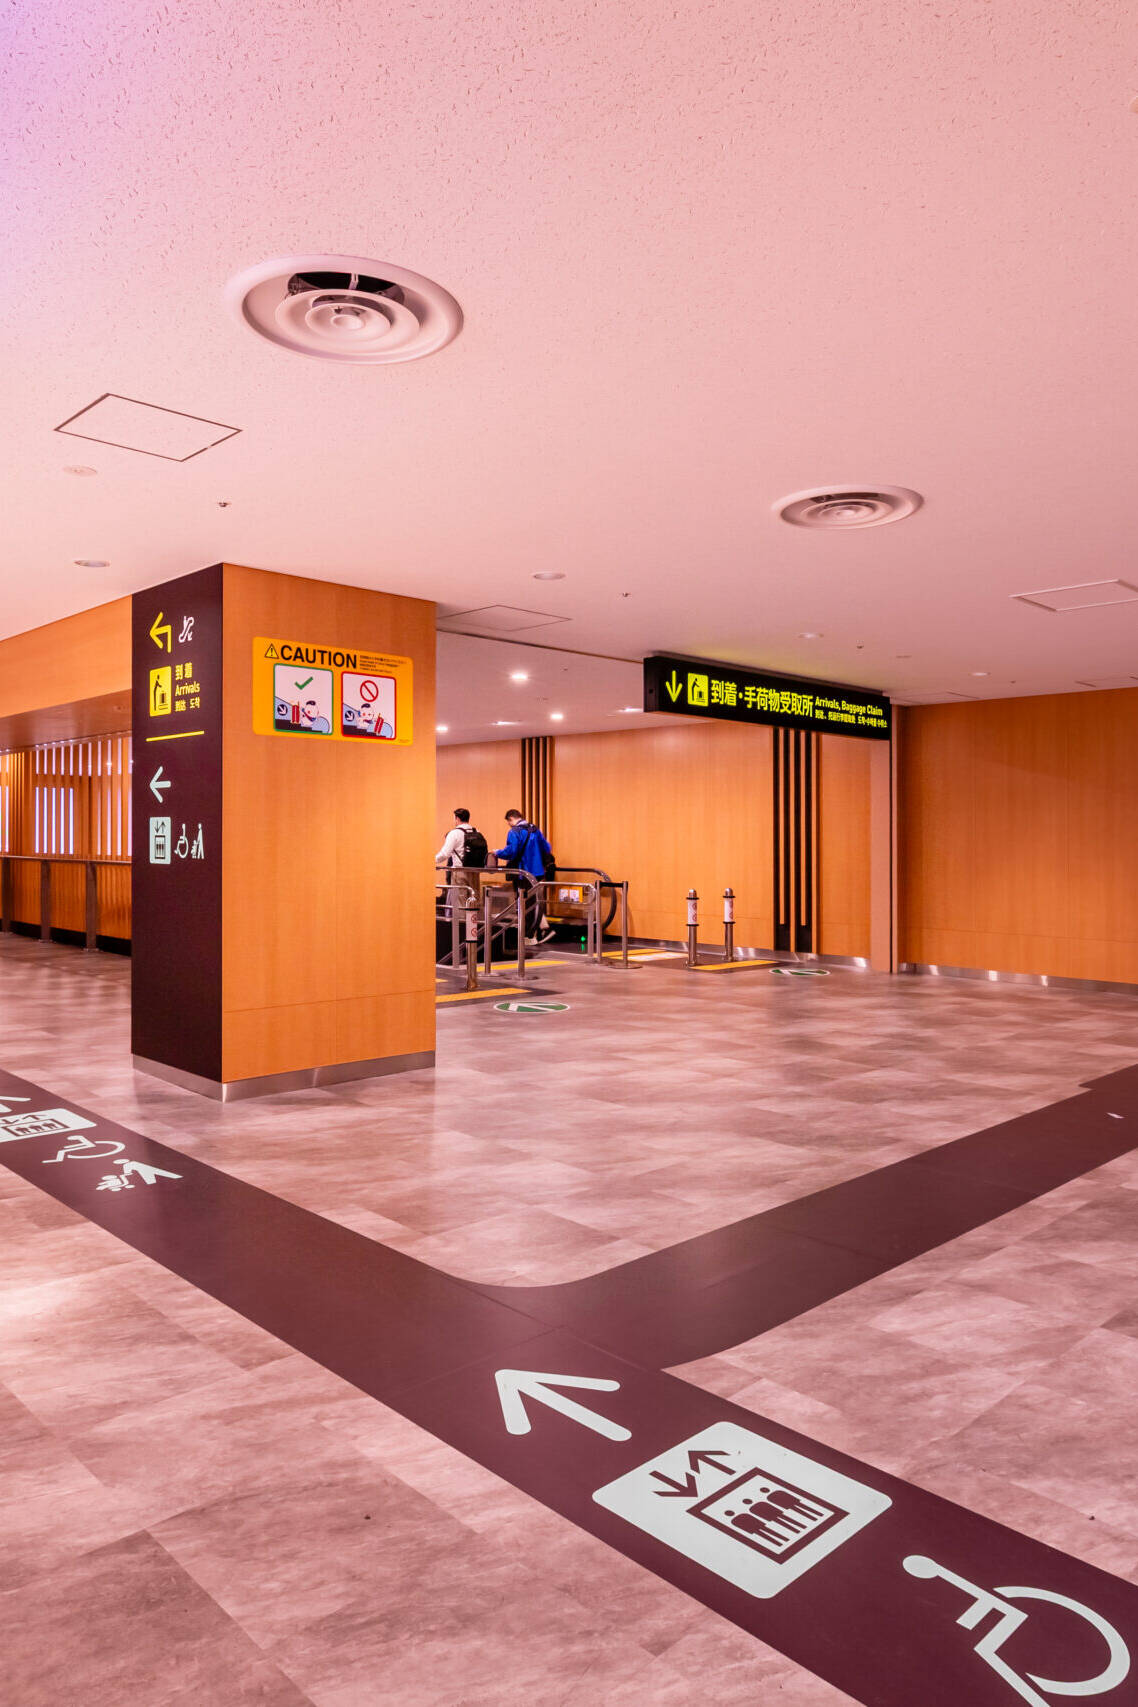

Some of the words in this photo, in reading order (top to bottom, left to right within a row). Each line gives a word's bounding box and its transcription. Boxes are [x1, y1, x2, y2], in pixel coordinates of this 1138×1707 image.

[280, 644, 357, 669] CAUTION
[175, 662, 193, 680] 到着
[174, 681, 200, 696] Arrivals
[815, 696, 841, 710] Arrivals,
[841, 700, 866, 714] Baggage
[867, 704, 883, 716] Claim
